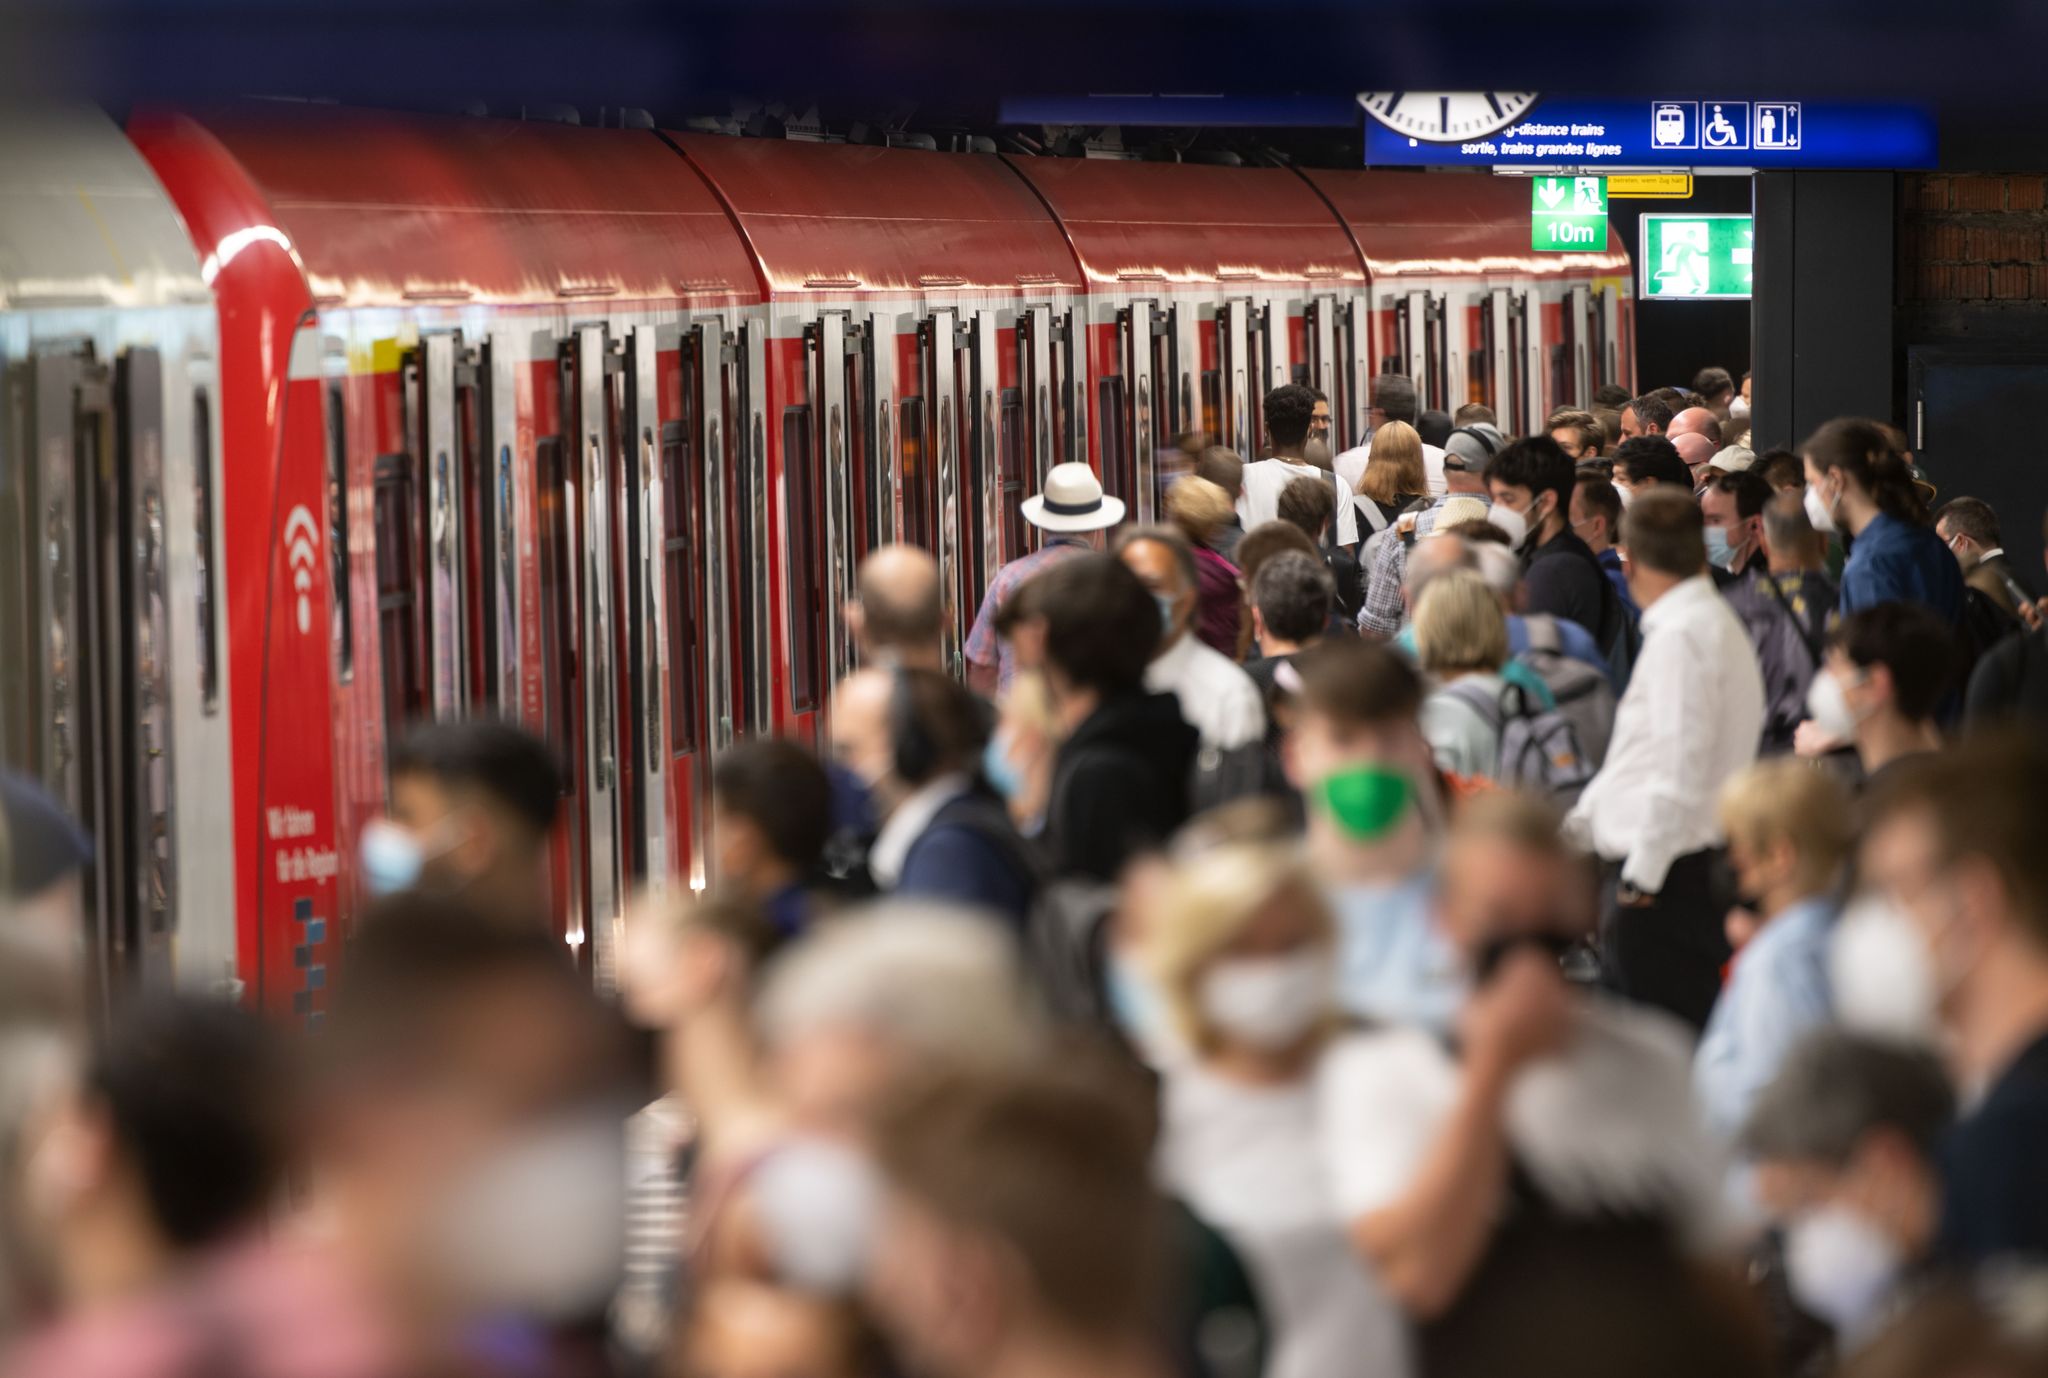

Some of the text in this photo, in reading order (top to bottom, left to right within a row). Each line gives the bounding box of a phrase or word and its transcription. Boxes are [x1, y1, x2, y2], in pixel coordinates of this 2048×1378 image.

[1571, 123, 1605, 136] trains
[1461, 141, 1622, 158] sortie, trains grandes lignes
[1547, 222, 1595, 243] 10m
